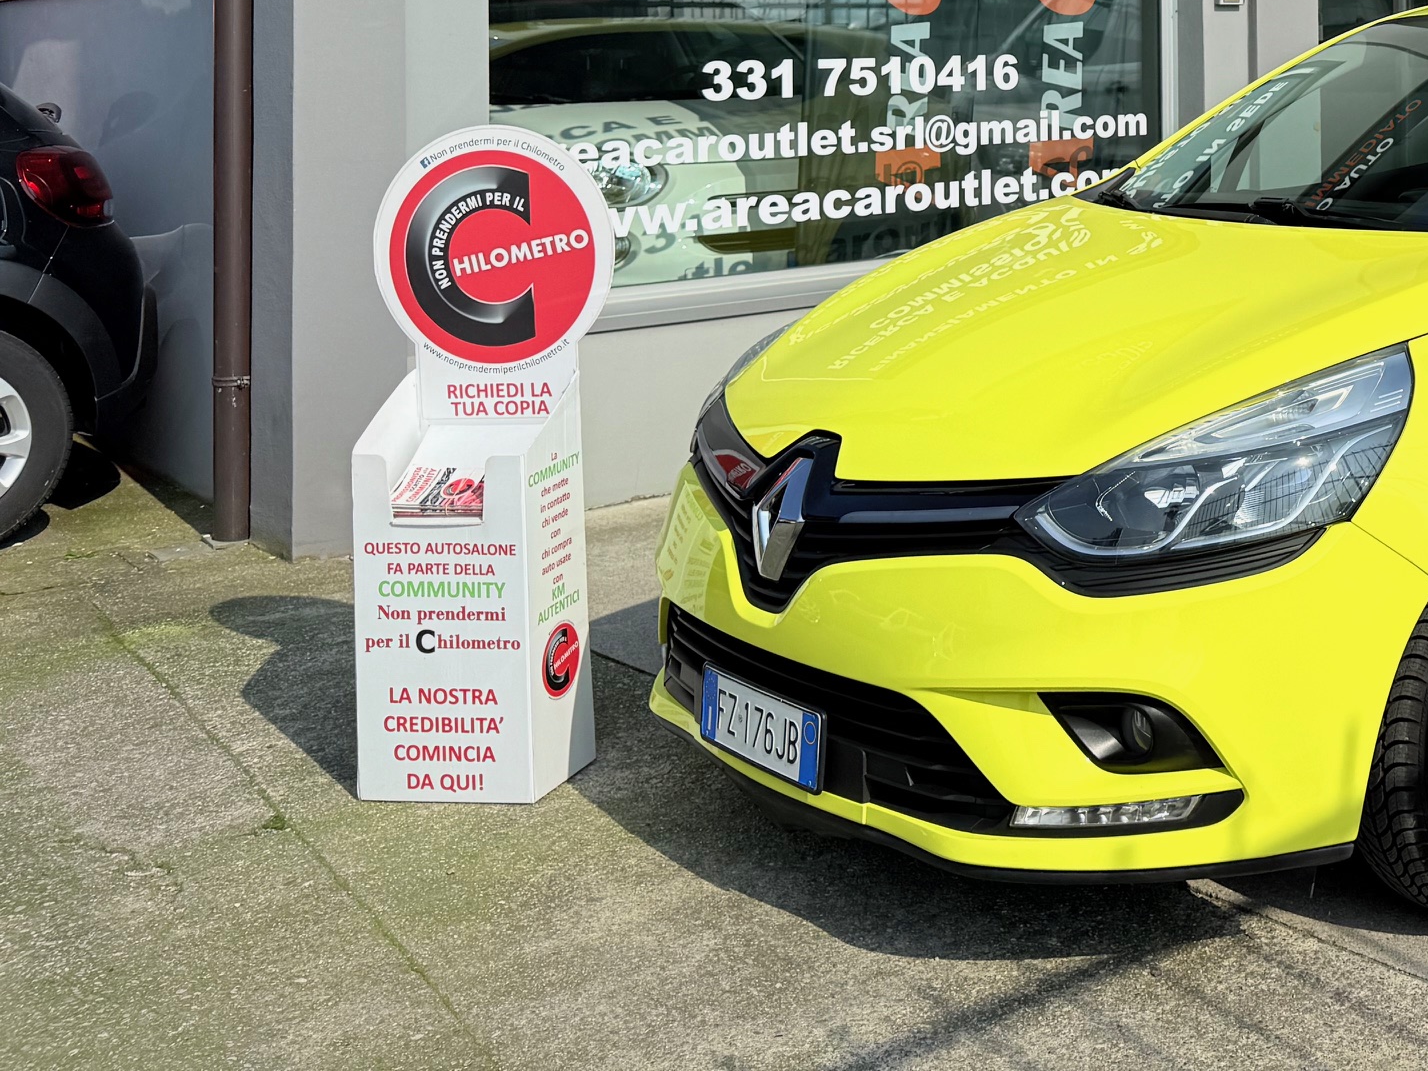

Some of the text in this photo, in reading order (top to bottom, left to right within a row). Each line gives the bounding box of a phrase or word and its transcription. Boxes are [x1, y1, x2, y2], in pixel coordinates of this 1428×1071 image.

[701, 54, 1020, 102] 331 7510416
[430, 136, 566, 172] Non prendermi per il Chilometro
[431, 191, 526, 290] NON PRENDERMI PER IL
[447, 382, 553, 400] RICHIEDI LA
[451, 399, 550, 417] TUA COPIA
[550, 451, 558, 461] La
[527, 451, 580, 487] COMMUNITY
[540, 476, 569, 498] che mette
[540, 491, 571, 513] in contatto
[541, 507, 569, 529] chi vende
[550, 527, 561, 540] con
[364, 542, 517, 556] QUESTO AUTOSALONE
[541, 536, 572, 560] chi compra
[387, 562, 496, 577] FA PARTE DELLA
[541, 552, 572, 576] auto usate
[552, 572, 564, 585] con
[378, 580, 506, 599] COMMUNITY
[551, 582, 565, 602] KM
[377, 605, 506, 624] Non prendermi
[537, 588, 580, 626] AUTENTICI
[365, 629, 521, 654] per il Chilometro
[389, 686, 498, 705] LA NOSTRA
[394, 744, 496, 763] COMINCIA
[407, 773, 484, 793] DA QUI!
